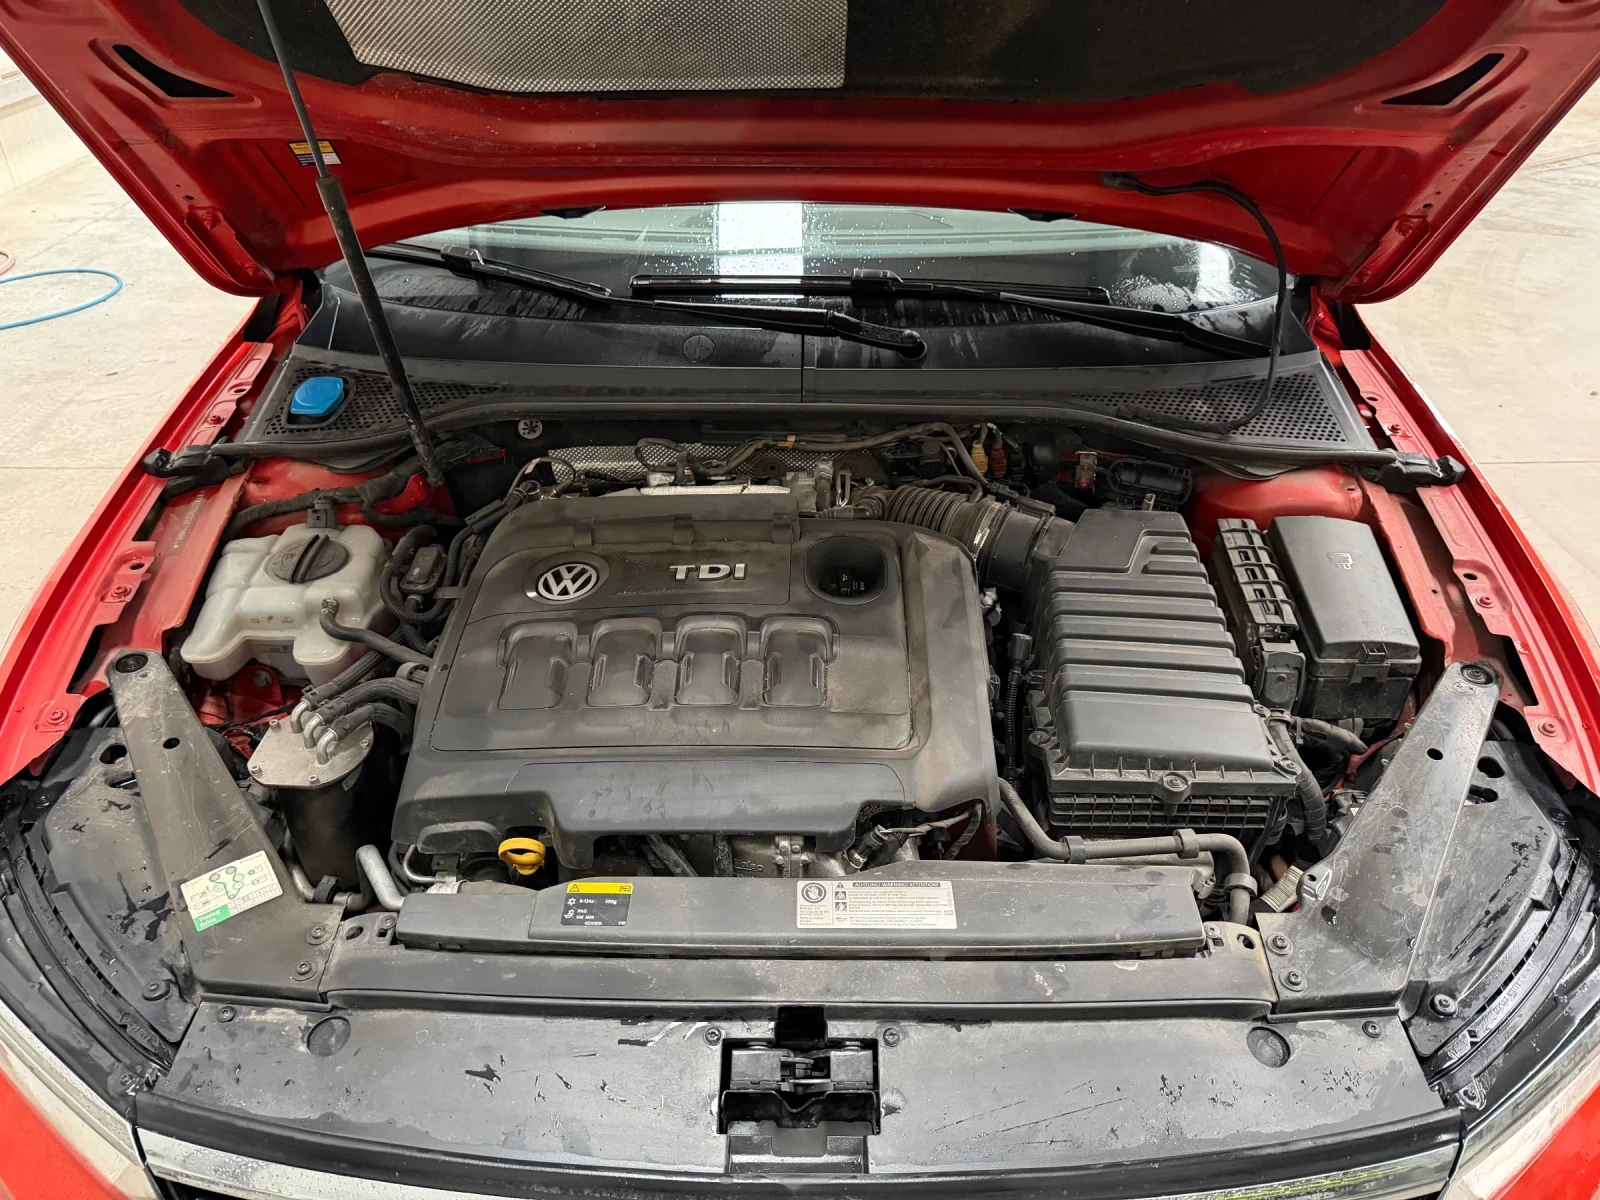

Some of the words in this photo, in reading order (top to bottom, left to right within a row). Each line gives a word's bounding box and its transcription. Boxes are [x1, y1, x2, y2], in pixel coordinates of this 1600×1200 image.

[669, 563, 747, 582] TDI
[199, 909, 221, 922] Timing
[200, 917, 217, 928] Drive
